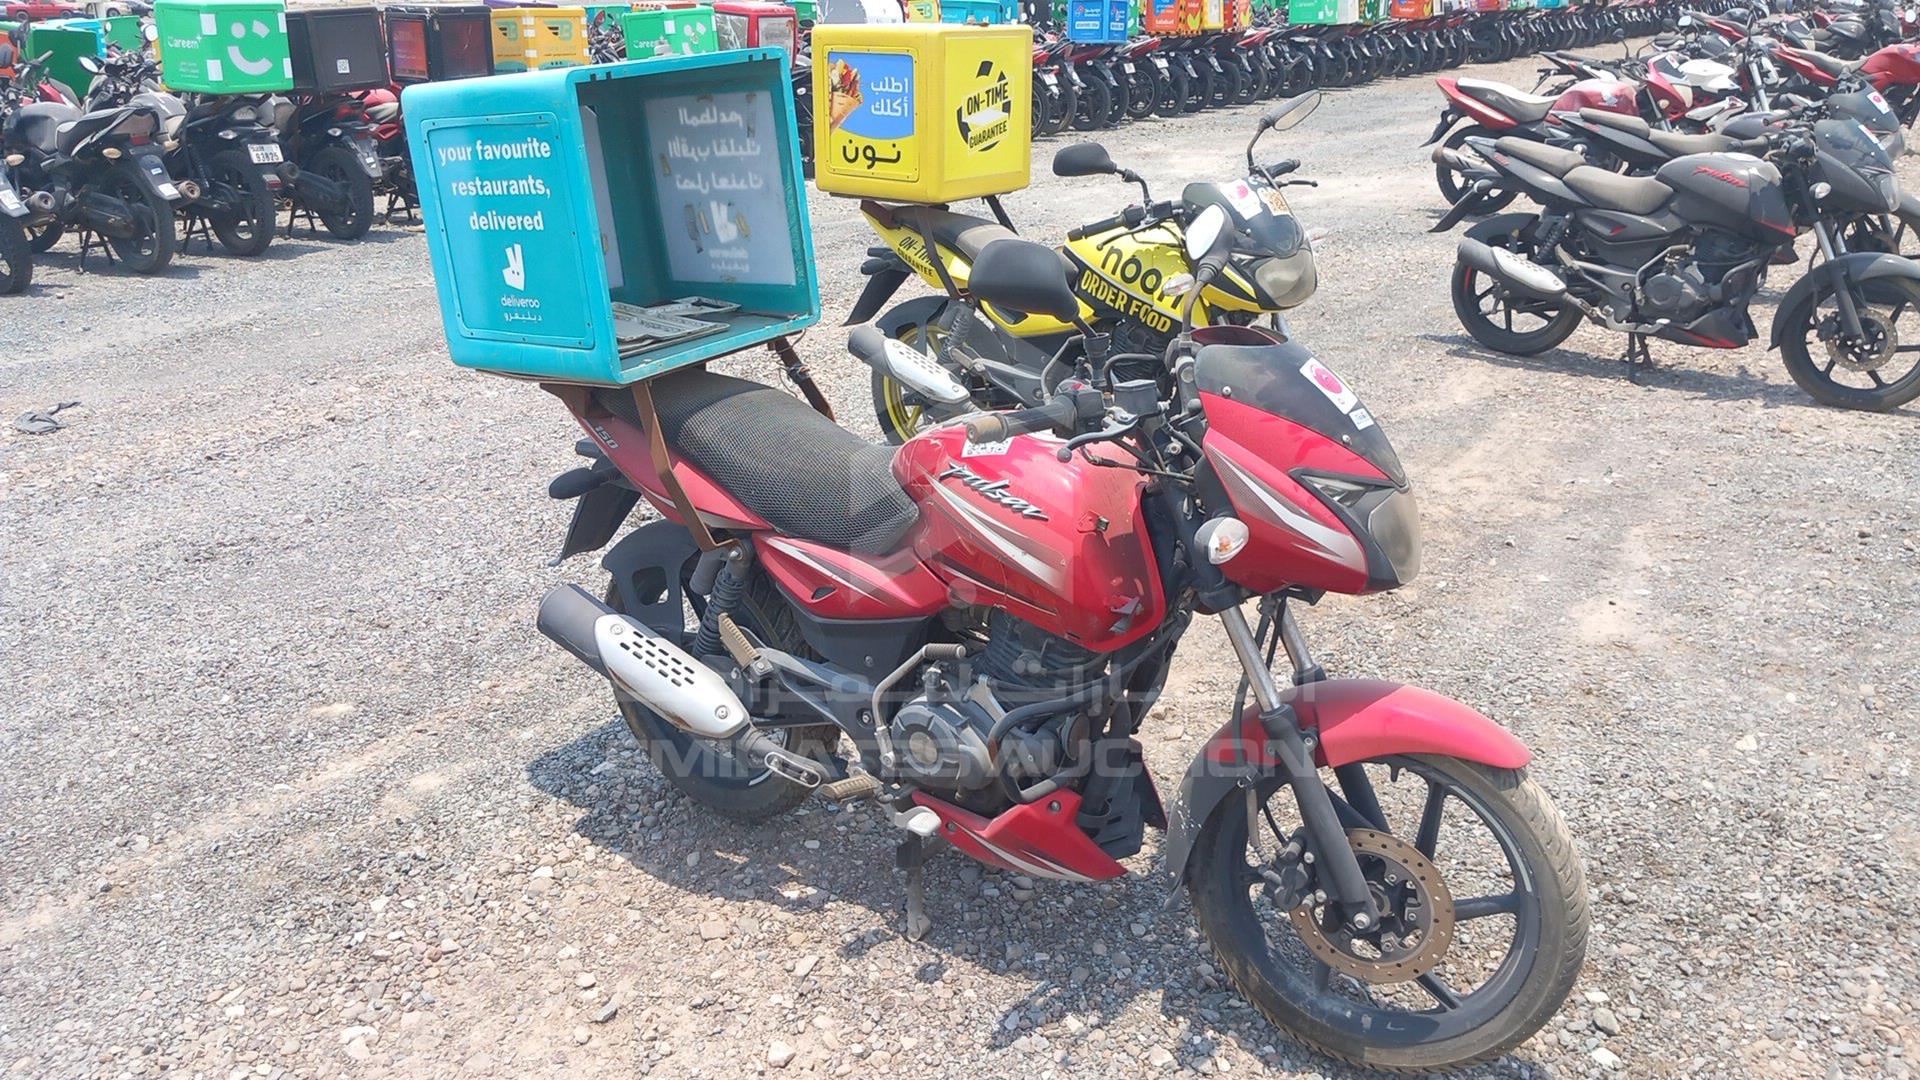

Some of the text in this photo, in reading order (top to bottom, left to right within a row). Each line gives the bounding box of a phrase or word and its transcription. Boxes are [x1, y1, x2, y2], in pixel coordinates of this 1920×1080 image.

[871, 77, 909, 95] اطلب
[967, 82, 1009, 116] ON-TIME
[871, 97, 909, 117] أكلك
[969, 120, 1008, 148] GUARANTEE
[438, 137, 551, 166] your favourite
[842, 139, 901, 169] نون
[452, 175, 552, 198] restaurants,
[469, 211, 544, 231] delivered
[899, 236, 935, 264] ON-TIM
[501, 295, 540, 308] deliveroo
[1080, 269, 1172, 333] ORDER FOOD
